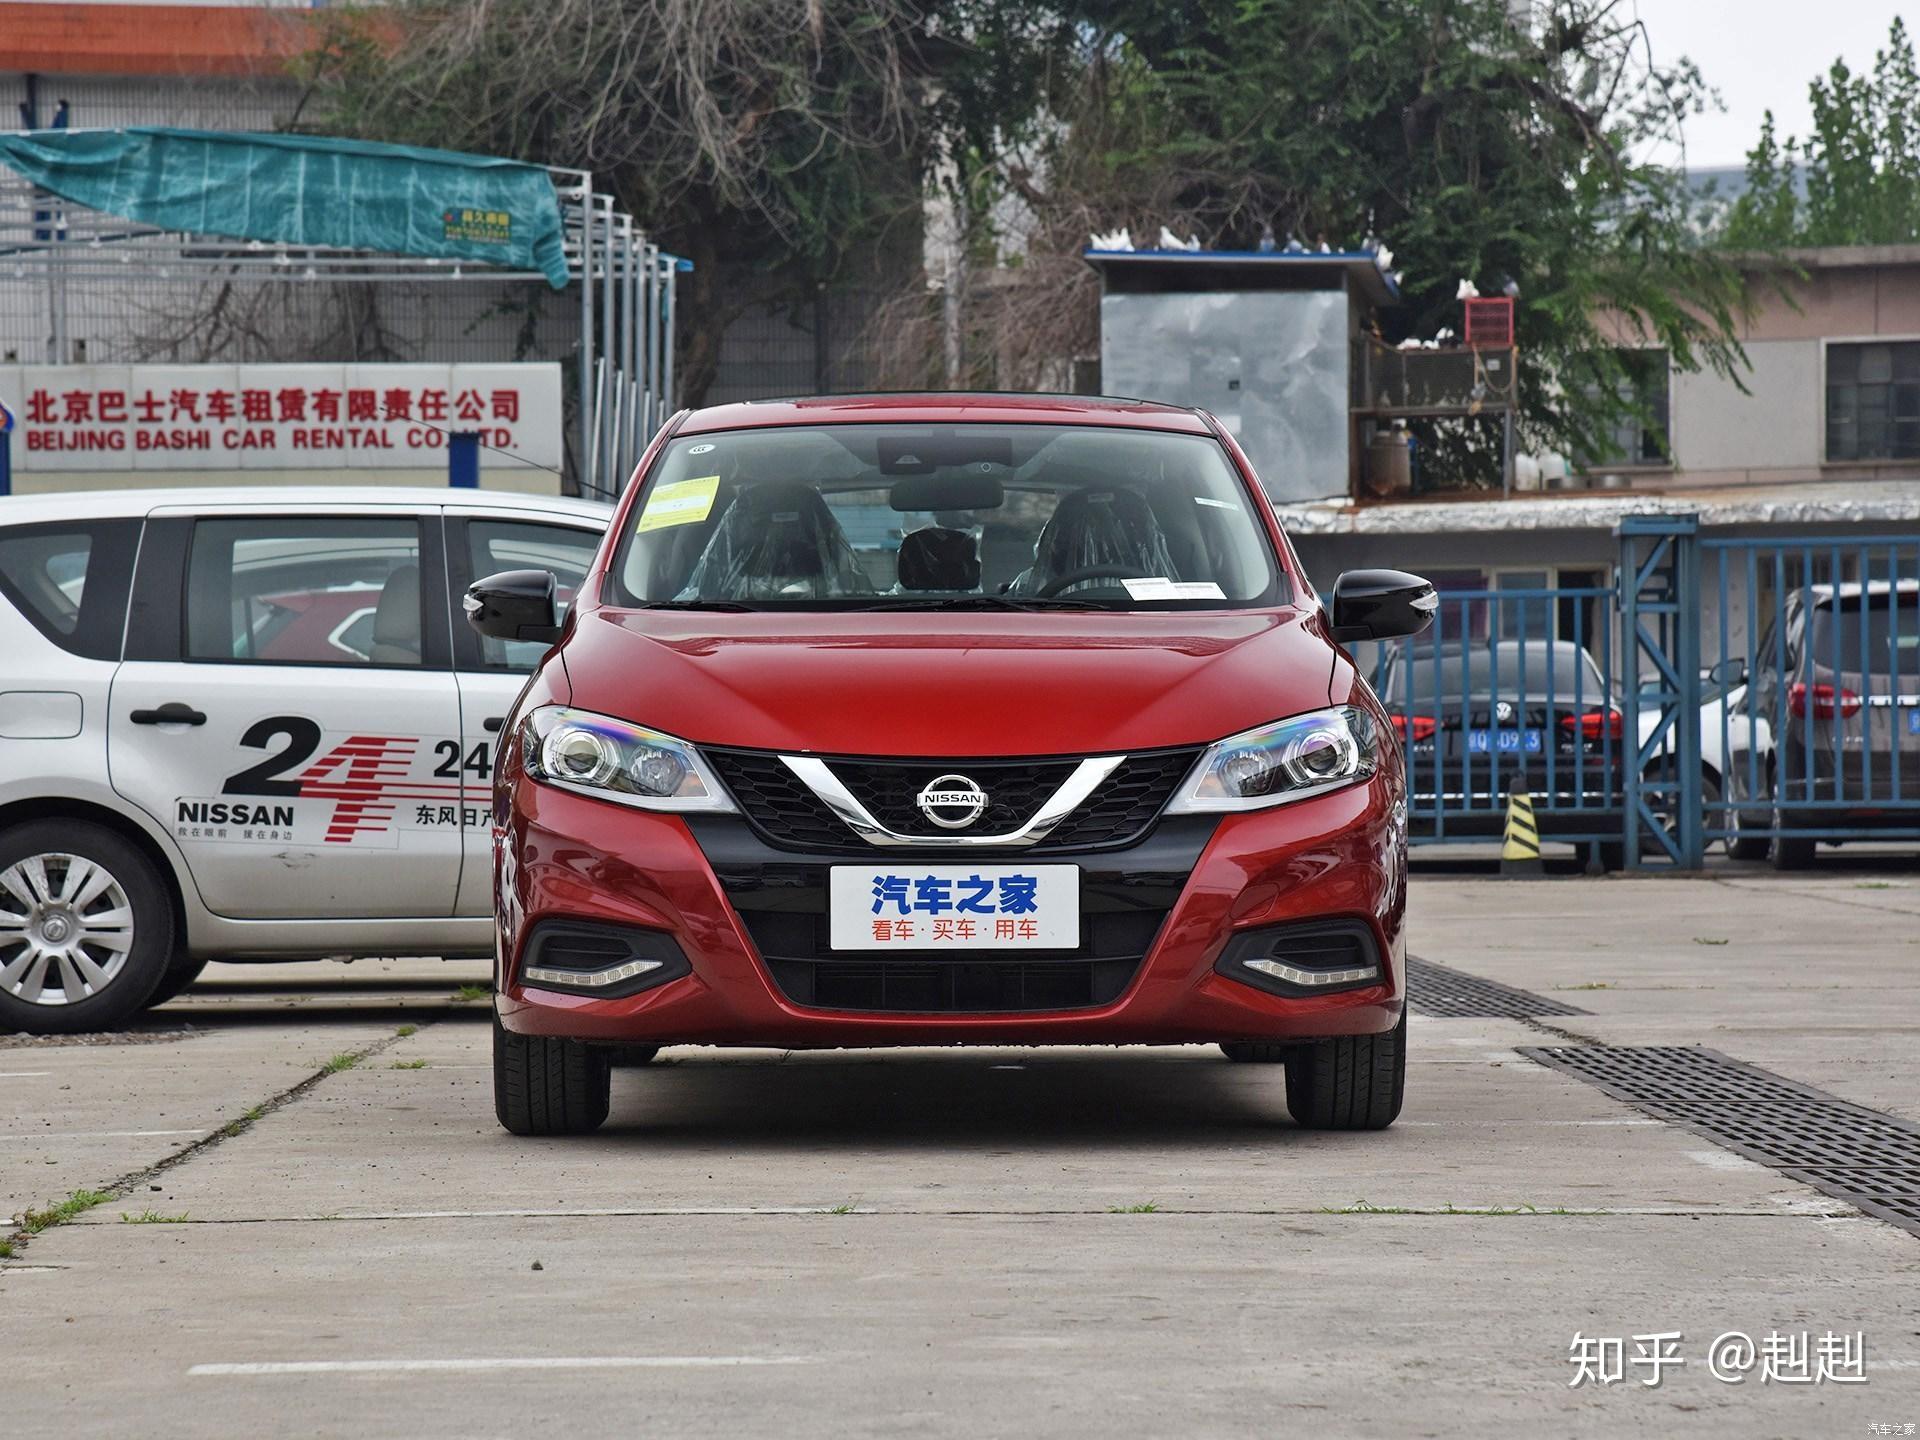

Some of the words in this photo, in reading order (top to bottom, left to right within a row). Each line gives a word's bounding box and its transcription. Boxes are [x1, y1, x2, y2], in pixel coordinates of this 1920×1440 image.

[26, 389, 519, 424] 北京巴士汽车租赁有限责任公司
[27, 430, 125, 450] BEIJING
[136, 429, 211, 450] BASHI
[223, 428, 277, 448] CAR
[293, 428, 394, 449] RENTAL
[464, 428, 518, 448] TD.
[433, 740, 493, 779] 24
[925, 794, 981, 803] NISSAN
[179, 802, 294, 826] NISSAN
[871, 874, 1039, 915] 汽车之家
